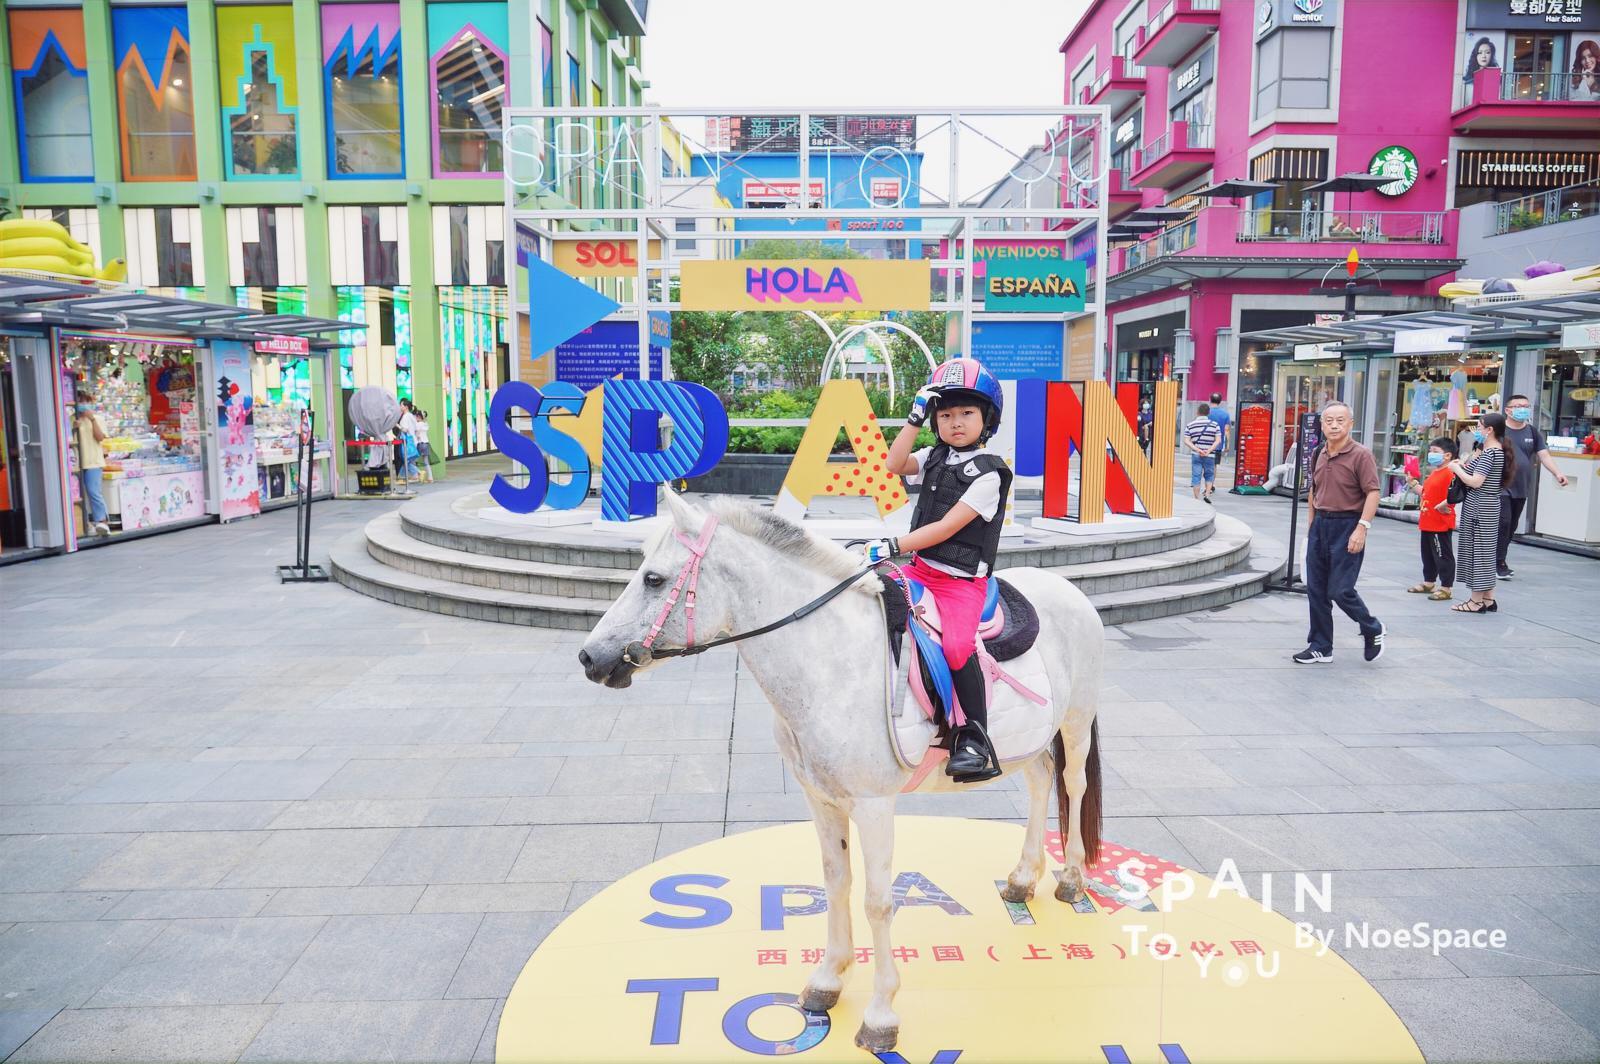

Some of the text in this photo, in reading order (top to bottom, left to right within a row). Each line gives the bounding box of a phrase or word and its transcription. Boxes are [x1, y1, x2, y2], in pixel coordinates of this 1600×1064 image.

[1292, 13, 1324, 22] mentor
[1545, 15, 1582, 23] Hair Salon
[1481, 163, 1586, 173] STARBUCKS COFFEE
[575, 240, 637, 268] SOL
[745, 266, 851, 296] HOLA
[989, 273, 1077, 295] ESPAÑA
[269, 339, 303, 351] HELLO BOX
